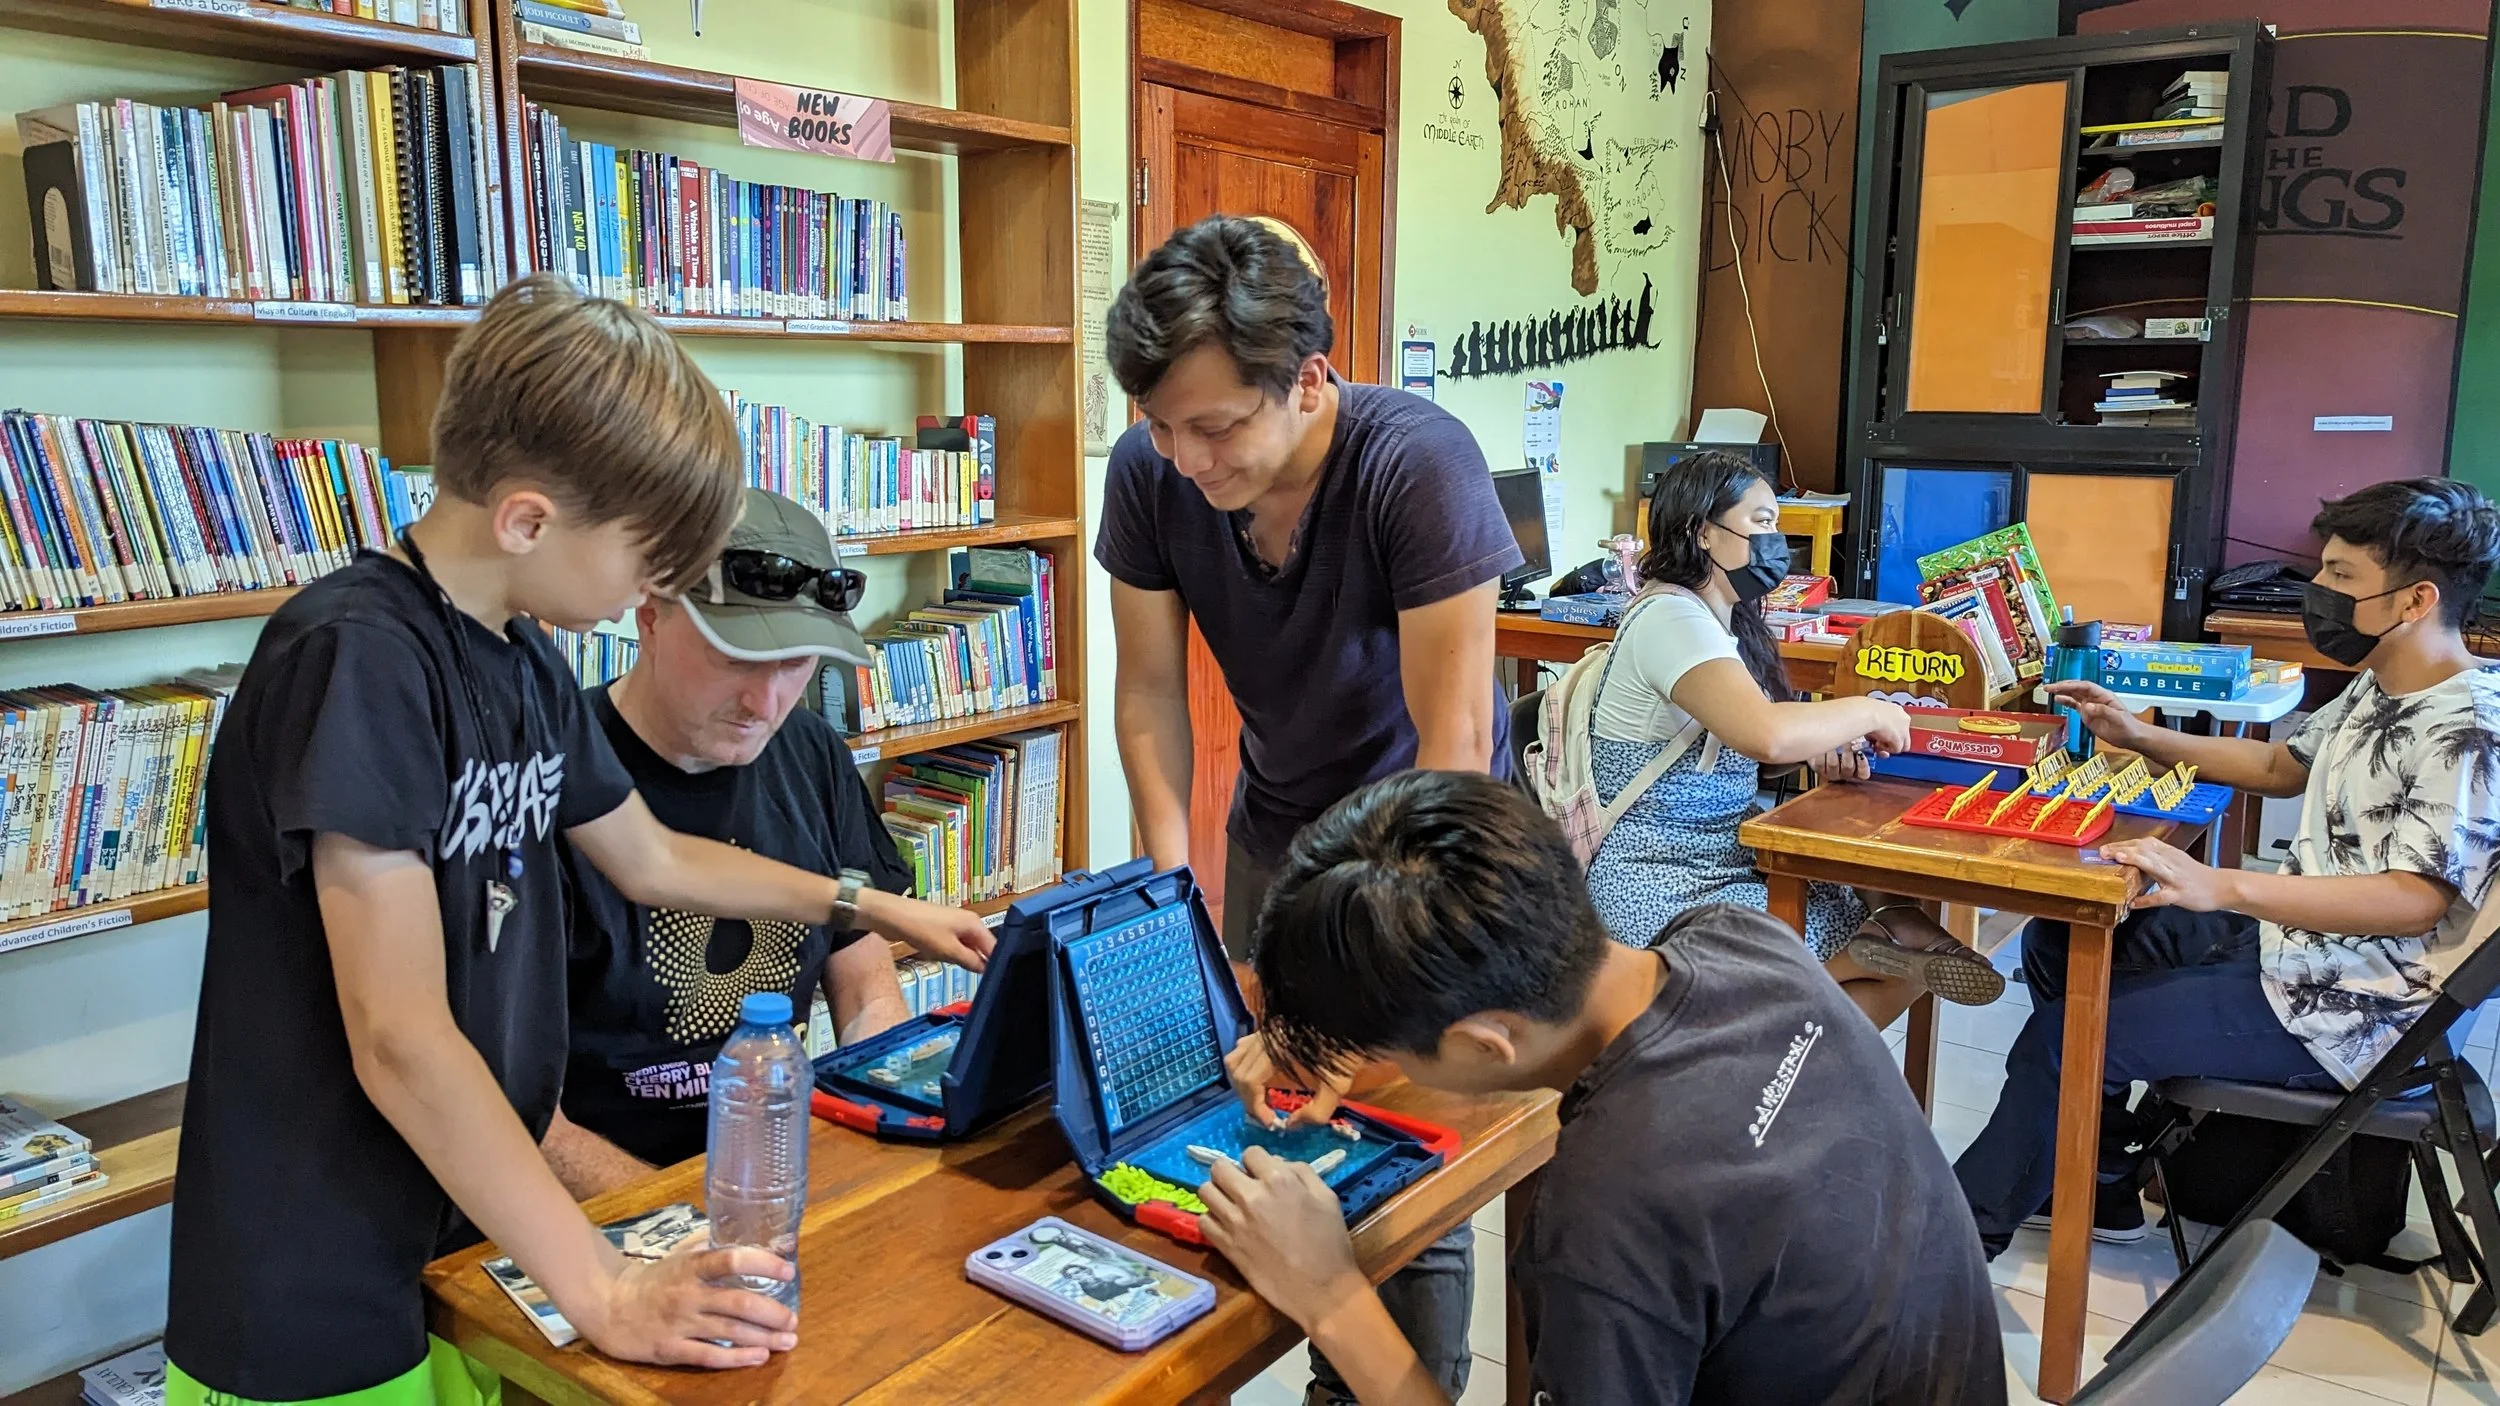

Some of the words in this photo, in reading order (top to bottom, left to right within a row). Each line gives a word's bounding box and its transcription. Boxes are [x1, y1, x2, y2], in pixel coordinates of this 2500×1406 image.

[199, 0, 207, 9] a
[524, 6, 544, 17] JODI
[545, 9, 579, 25] PICOULT
[796, 92, 841, 117] NEW
[1555, 98, 1589, 111] ROHAN
[754, 109, 780, 134] Age
[788, 117, 853, 146] BOOKS
[1717, 108, 1845, 192] MOBY
[2268, 146, 2323, 170] HE
[207, 151, 217, 188] YUCATAN
[534, 142, 544, 208] JUSTICE
[336, 192, 344, 220] MAYAS
[689, 199, 697, 208] A
[572, 211, 585, 234] NEW
[689, 209, 699, 244] Wrinkle
[1708, 189, 1837, 272] DICK
[2178, 221, 2197, 229] papel
[340, 239, 347, 249] DE
[538, 209, 549, 267] LEAGUE
[574, 235, 587, 251] KID
[741, 232, 749, 260] Smile
[691, 246, 699, 254] in
[341, 251, 350, 275] MILPA
[691, 256, 700, 278] Time
[256, 308, 286, 317] Mayan
[287, 307, 318, 317] Culture
[320, 308, 355, 320] (English)
[51, 461, 63, 480] LITTLE
[268, 504, 276, 517] BAD
[271, 518, 281, 534] GUYS
[1556, 606, 1569, 614] No
[1571, 606, 1598, 617] Stress
[1564, 613, 1589, 623] Chess
[0, 624, 38, 634] ildren's
[41, 621, 74, 631] Fiction
[1867, 647, 1957, 679] RETURN
[2129, 652, 2218, 665] SCRABBLE
[2105, 675, 2202, 691] RABBLE
[858, 751, 880, 761] Fiction
[15, 785, 25, 795] Dr.
[27, 783, 36, 793] Dr.
[50, 790, 59, 800] Fox
[12, 795, 24, 817] Seuss's
[24, 794, 35, 815] Seuss's
[37, 794, 46, 804] Fox
[47, 921, 96, 937] Children's
[98, 914, 131, 927] Fiction
[1087, 945, 1092, 956] 1
[1097, 941, 1103, 952] 2
[1107, 937, 1114, 949] 3
[1118, 933, 1125, 943] 4
[1128, 929, 1135, 940] 5
[1139, 924, 1146, 935] 6
[1148, 920, 1154, 931] 7
[1158, 916, 1165, 927] 8
[1169, 912, 1175, 922] 9
[1177, 907, 1186, 920] 10
[1078, 967, 1086, 977] A
[1081, 983, 1089, 994] B
[1085, 1000, 1092, 1010] C
[1088, 1016, 1096, 1027] D
[1092, 1032, 1100, 1043] E
[1096, 1049, 1102, 1060] F
[622, 1065, 658, 1077] REDIT
[658, 1061, 689, 1071] UNION
[625, 1066, 690, 1085] CHERRY
[1100, 1065, 1107, 1077] G
[626, 1084, 670, 1099] TEN
[676, 1077, 709, 1099] MIL
[1103, 1081, 1111, 1092] H
[1108, 1098, 1113, 1109] I
[1112, 1114, 1119, 1126] J
